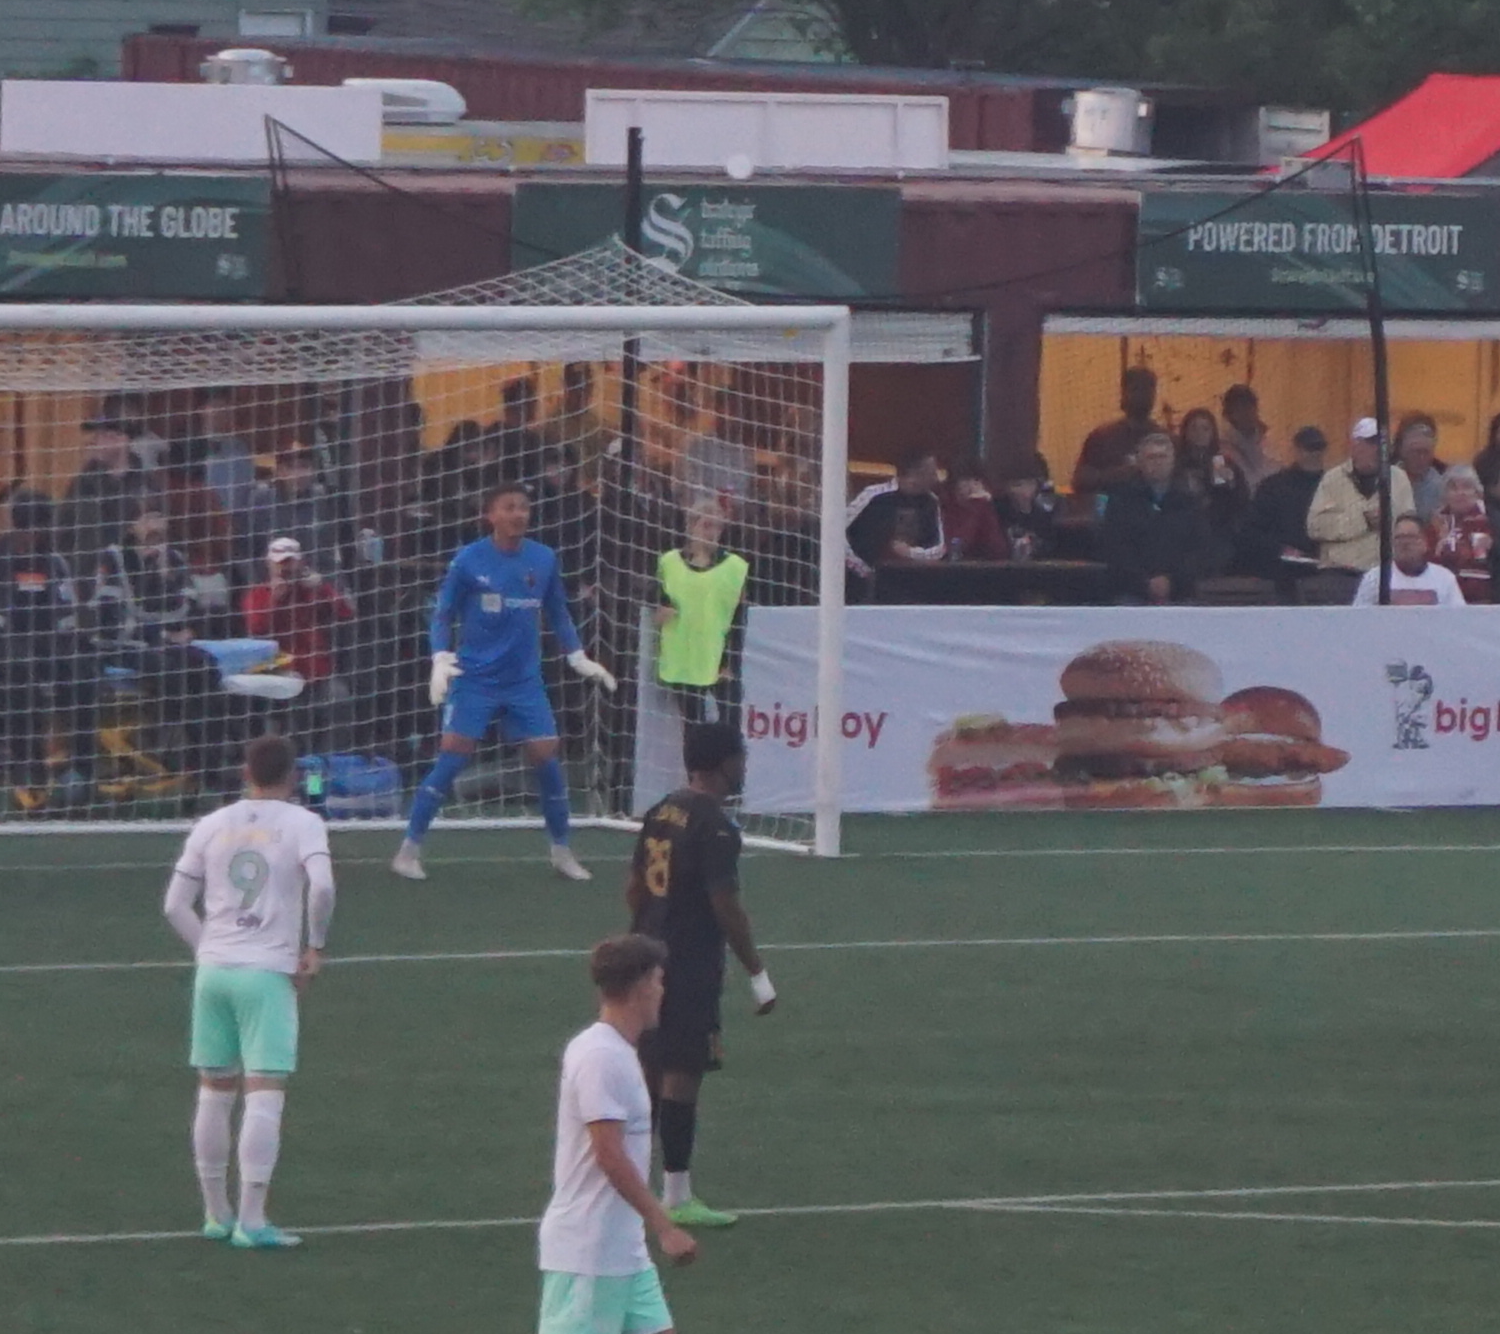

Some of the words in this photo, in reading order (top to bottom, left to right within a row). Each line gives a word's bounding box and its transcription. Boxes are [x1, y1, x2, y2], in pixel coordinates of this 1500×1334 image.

[0, 204, 99, 237] AROUND
[109, 205, 154, 237] THE
[161, 207, 239, 239] GLOBE
[1188, 222, 1296, 252] POWERED
[1371, 224, 1463, 255] DETROIT
[228, 850, 270, 910] 9
[645, 837, 673, 898] 8
